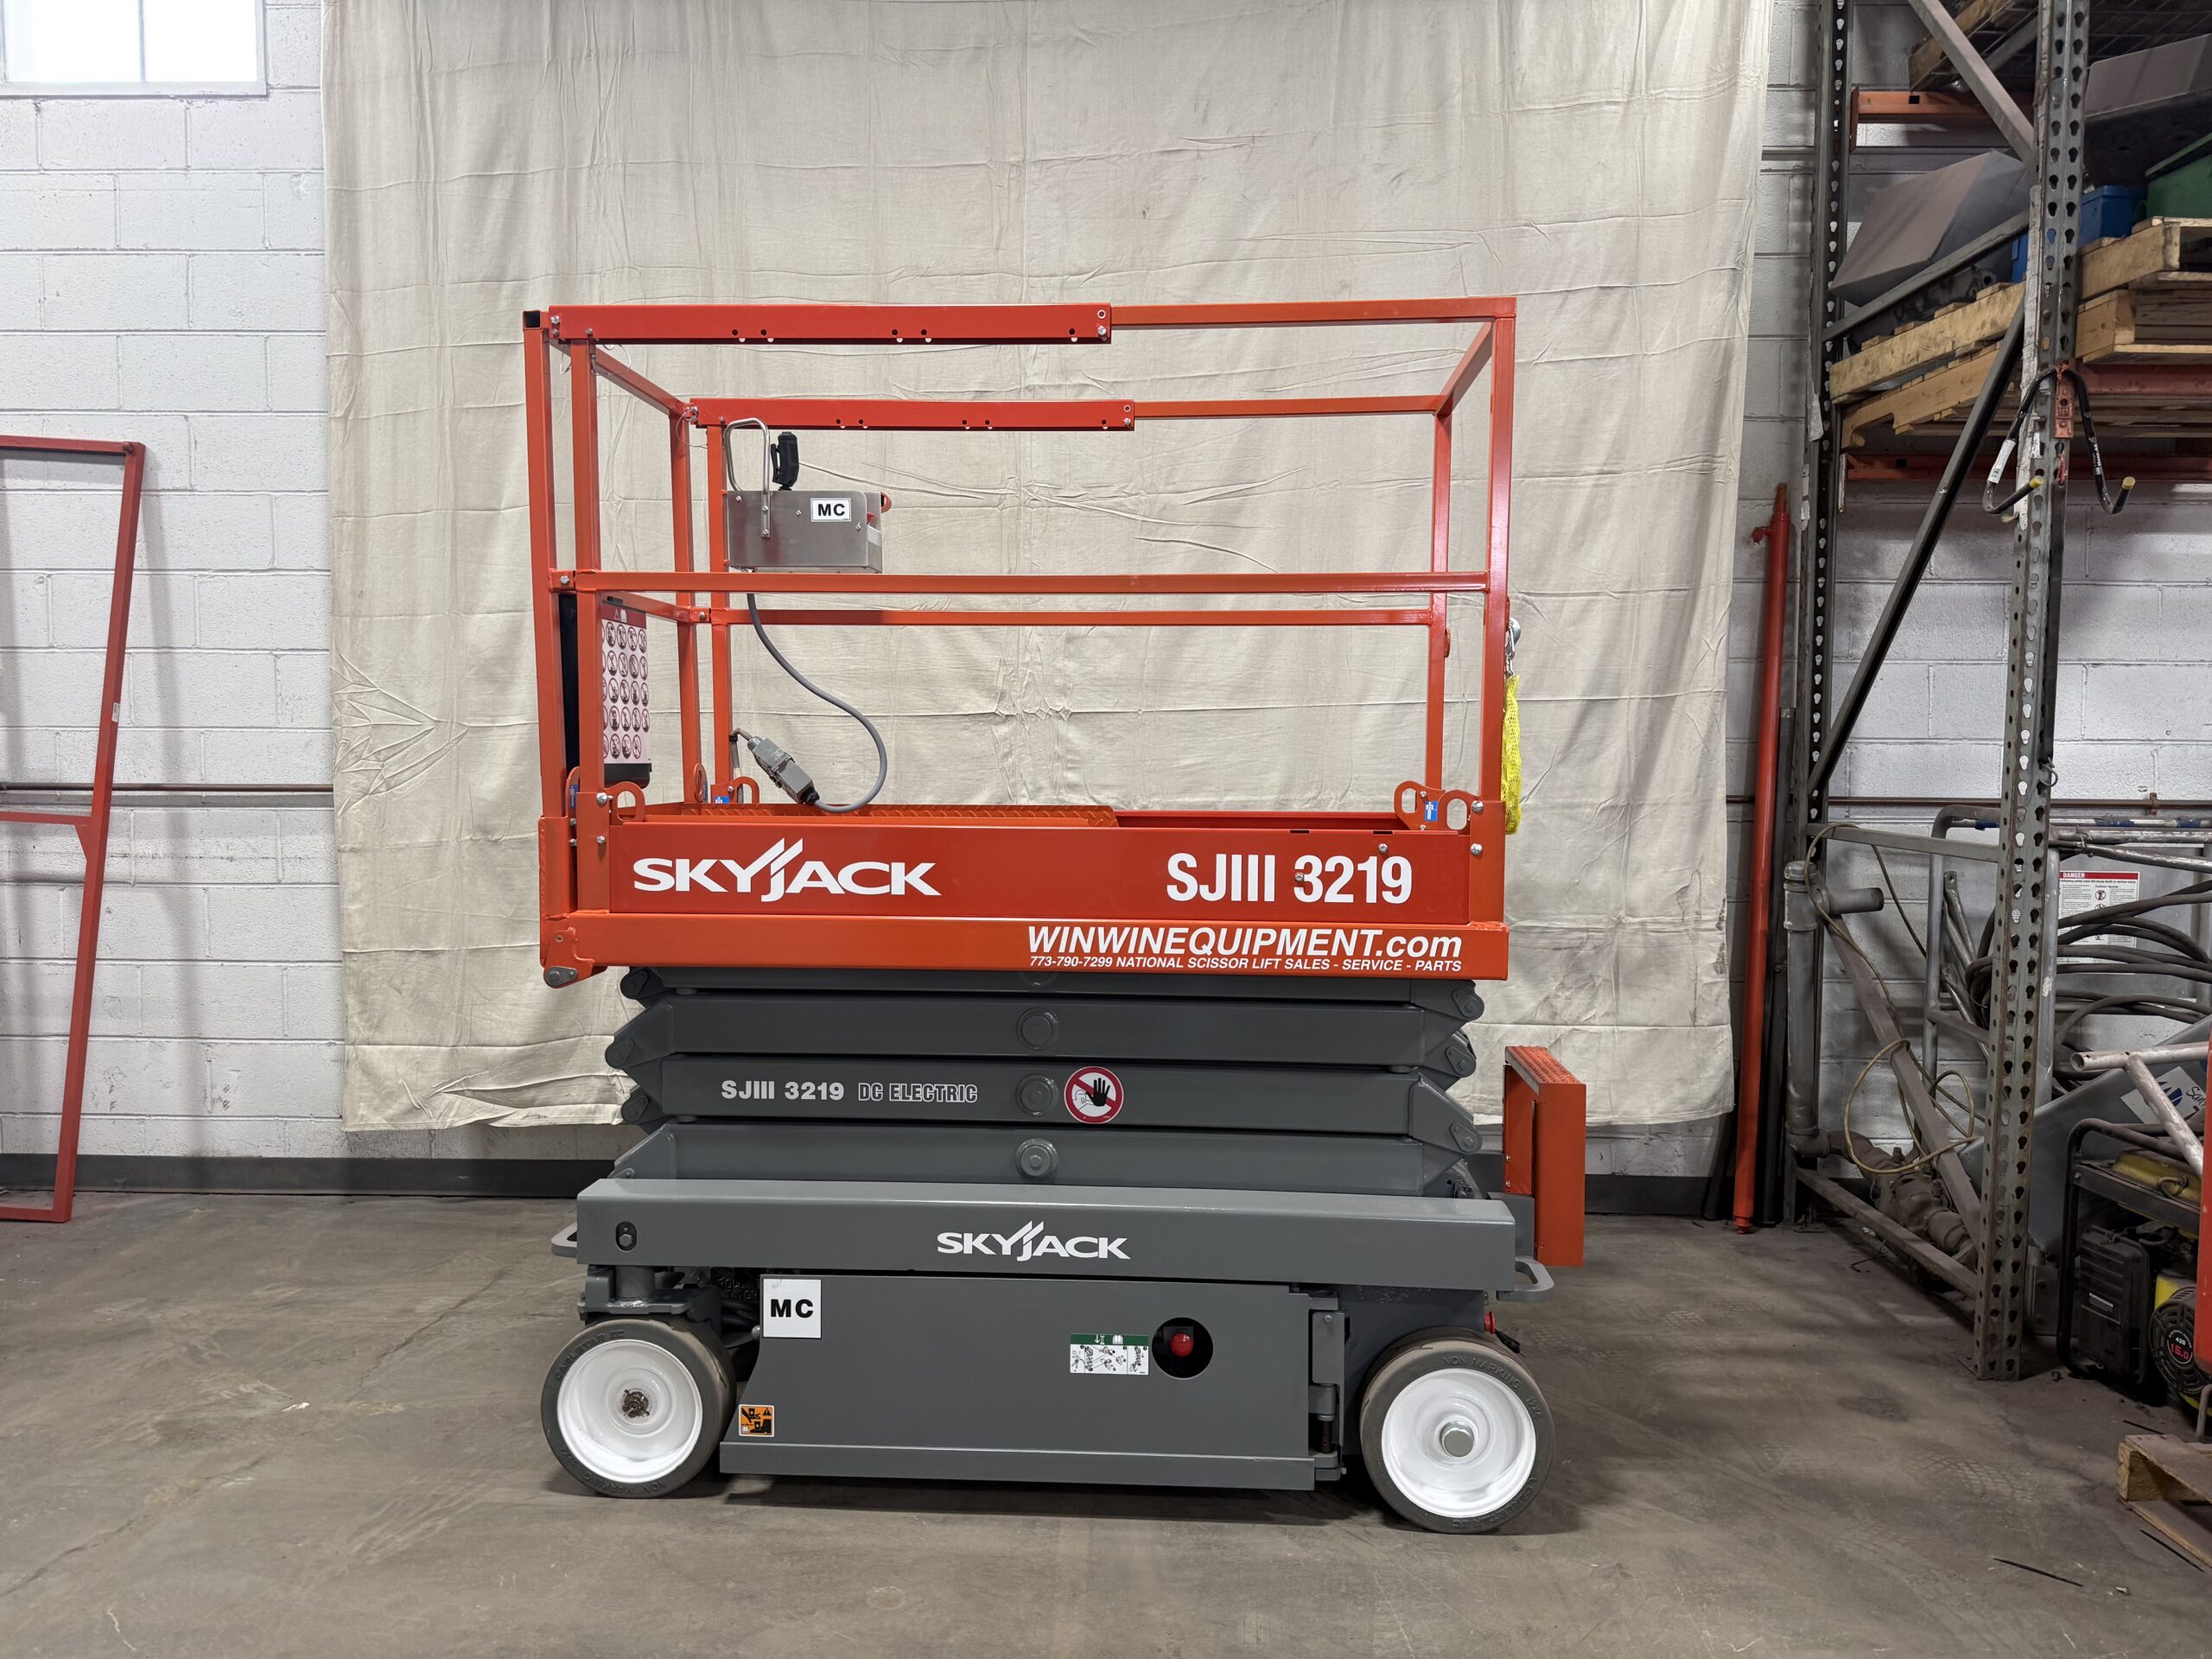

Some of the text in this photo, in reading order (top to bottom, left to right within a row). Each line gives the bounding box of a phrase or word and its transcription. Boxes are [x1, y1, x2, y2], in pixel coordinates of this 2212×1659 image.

[817, 503, 846, 517] MC
[632, 837, 942, 902] SKYJACK
[1166, 853, 1413, 905] SJIII 3219
[1028, 925, 1462, 958] WINWINEQUIPMENT.com
[1030, 956, 1113, 968] 773-790-7299
[1116, 956, 1184, 969] NATIONAL
[1187, 957, 1249, 969] SCISSOR
[1252, 957, 1282, 969] LIFT
[1284, 958, 1332, 969] SALES
[1342, 958, 1404, 971] SERVICE
[1414, 959, 1462, 972] PARTS
[721, 1079, 978, 1103] SJIII 3219 DC ELECTRIC
[937, 1220, 1132, 1262] SKYJACK
[770, 1299, 814, 1319] MC
[2175, 1337, 2186, 1345] 420
